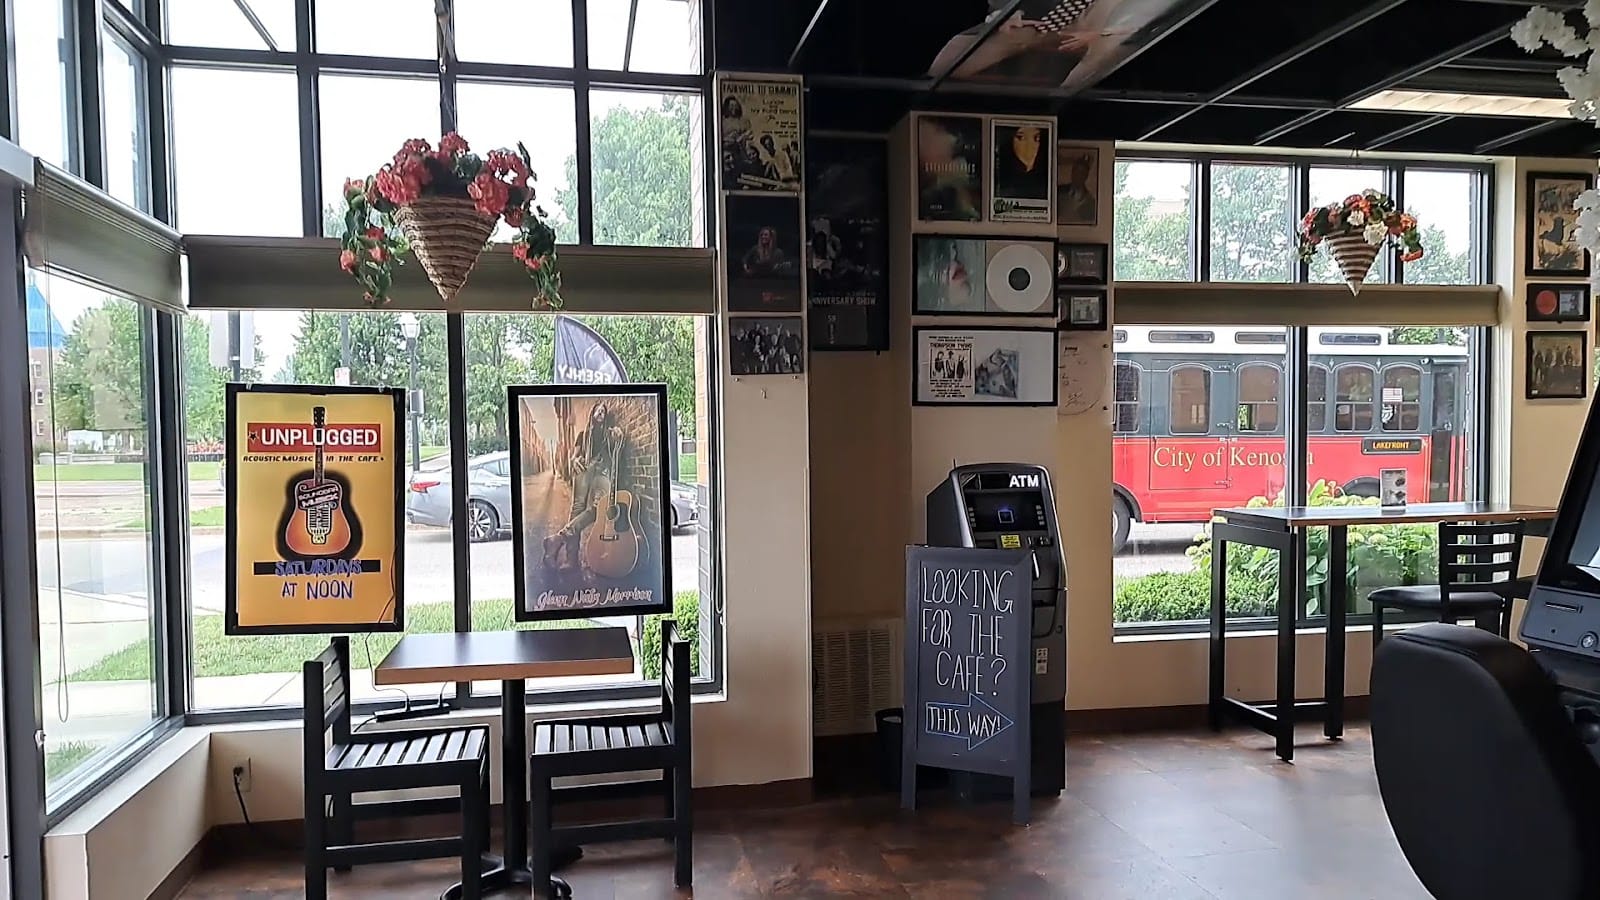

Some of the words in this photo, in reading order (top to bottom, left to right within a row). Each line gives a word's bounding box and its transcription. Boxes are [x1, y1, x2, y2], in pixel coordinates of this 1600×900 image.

[261, 427, 378, 446] UNPLUGGED
[1372, 440, 1410, 450] LAKEFRONT
[1153, 446, 1197, 472] City
[1202, 446, 1225, 467] of
[1009, 474, 1039, 488] ATM
[274, 559, 362, 578] SATURDAYS
[282, 582, 298, 597] AT
[306, 579, 353, 600] NOON
[922, 567, 1015, 614] LOOKING
[922, 608, 953, 649] FOR
[968, 613, 1004, 658] THE
[928, 706, 961, 735] THIS
[967, 710, 1002, 739] WAY!
